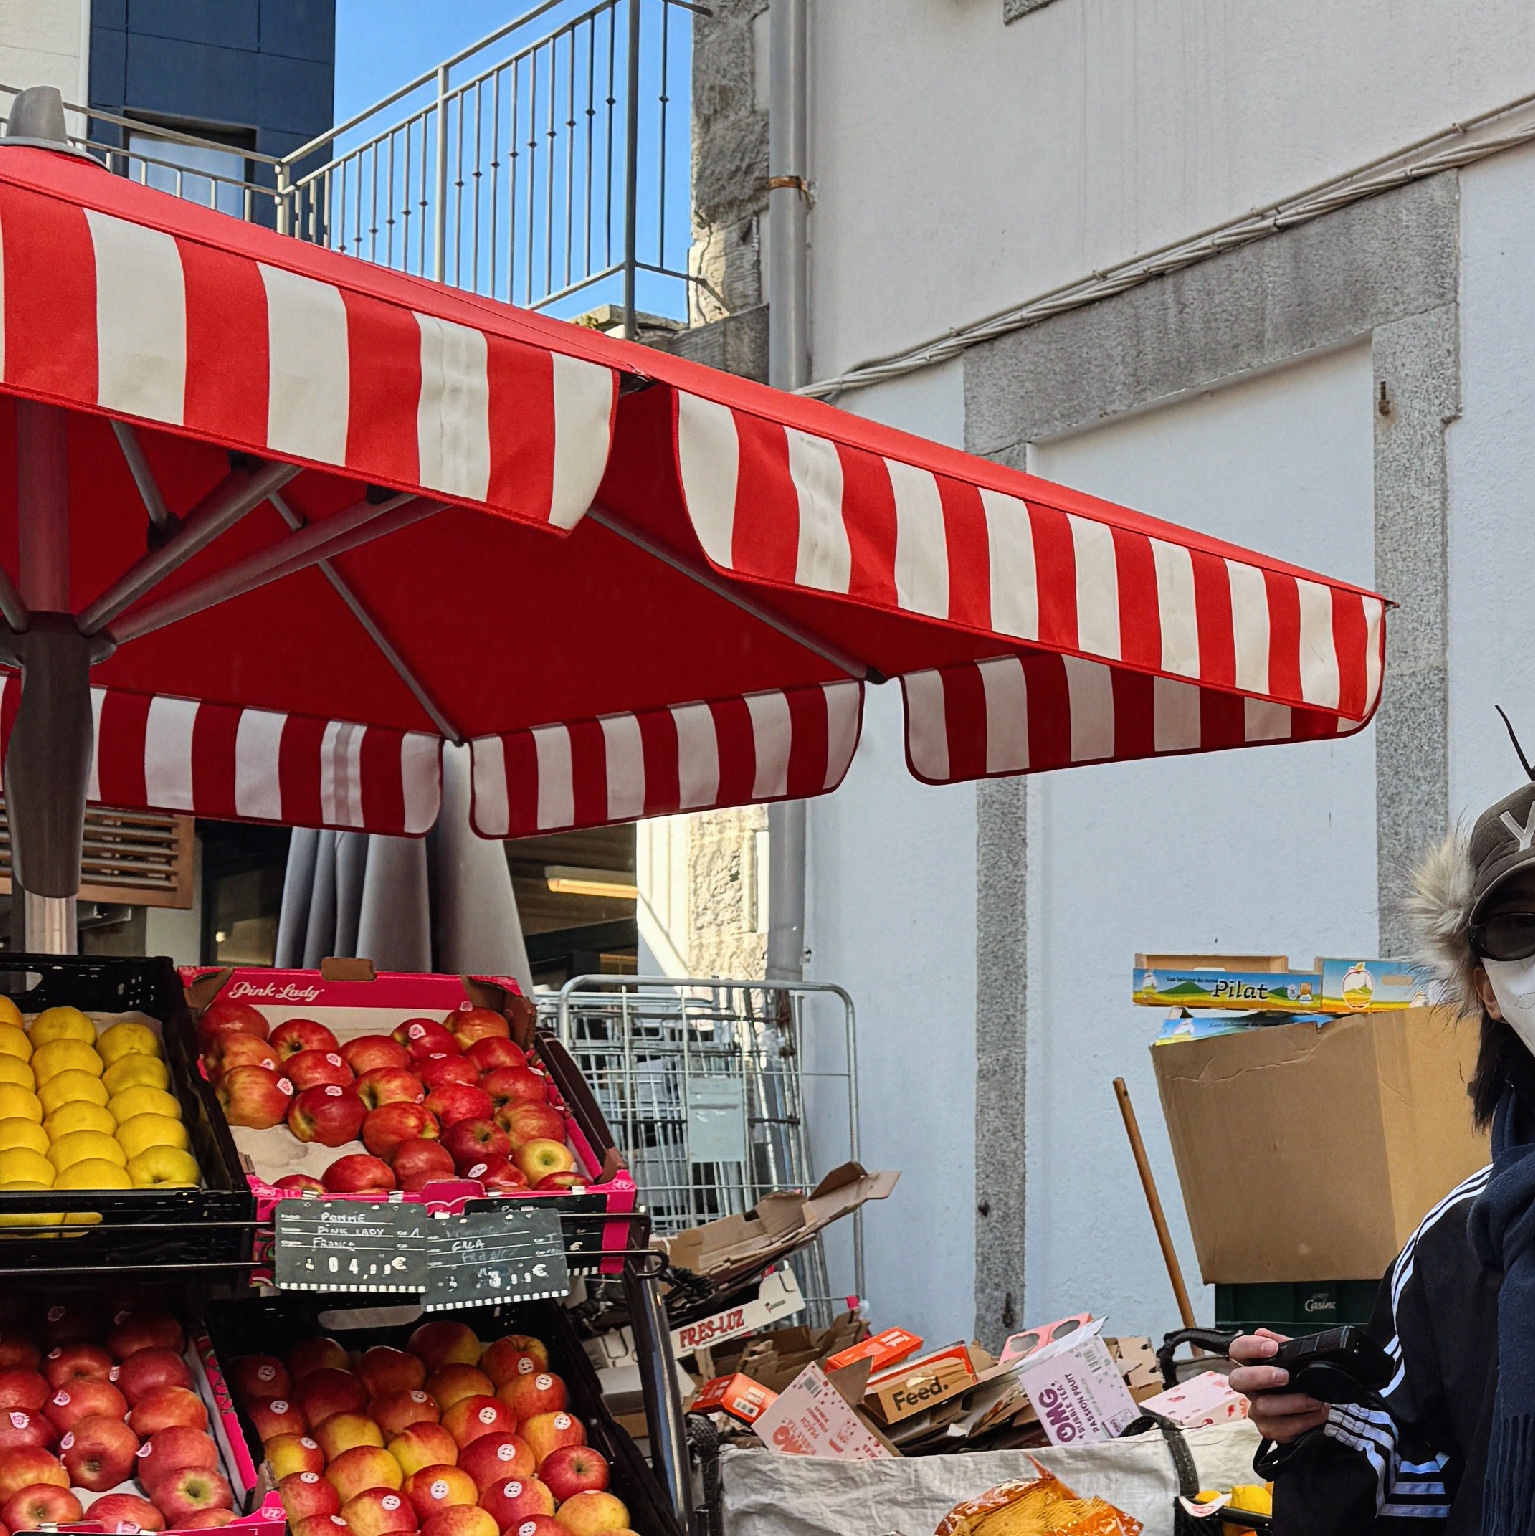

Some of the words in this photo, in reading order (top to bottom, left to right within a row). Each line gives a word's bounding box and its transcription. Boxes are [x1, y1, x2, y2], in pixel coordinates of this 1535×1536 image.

[228, 981, 276, 998] Pink
[276, 983, 320, 1001] Lady
[1212, 979, 1269, 1000] Pilat
[679, 1309, 745, 1349] FRES-LUZ
[892, 1376, 949, 1411] Feed.
[1038, 1388, 1076, 1443] OMG
